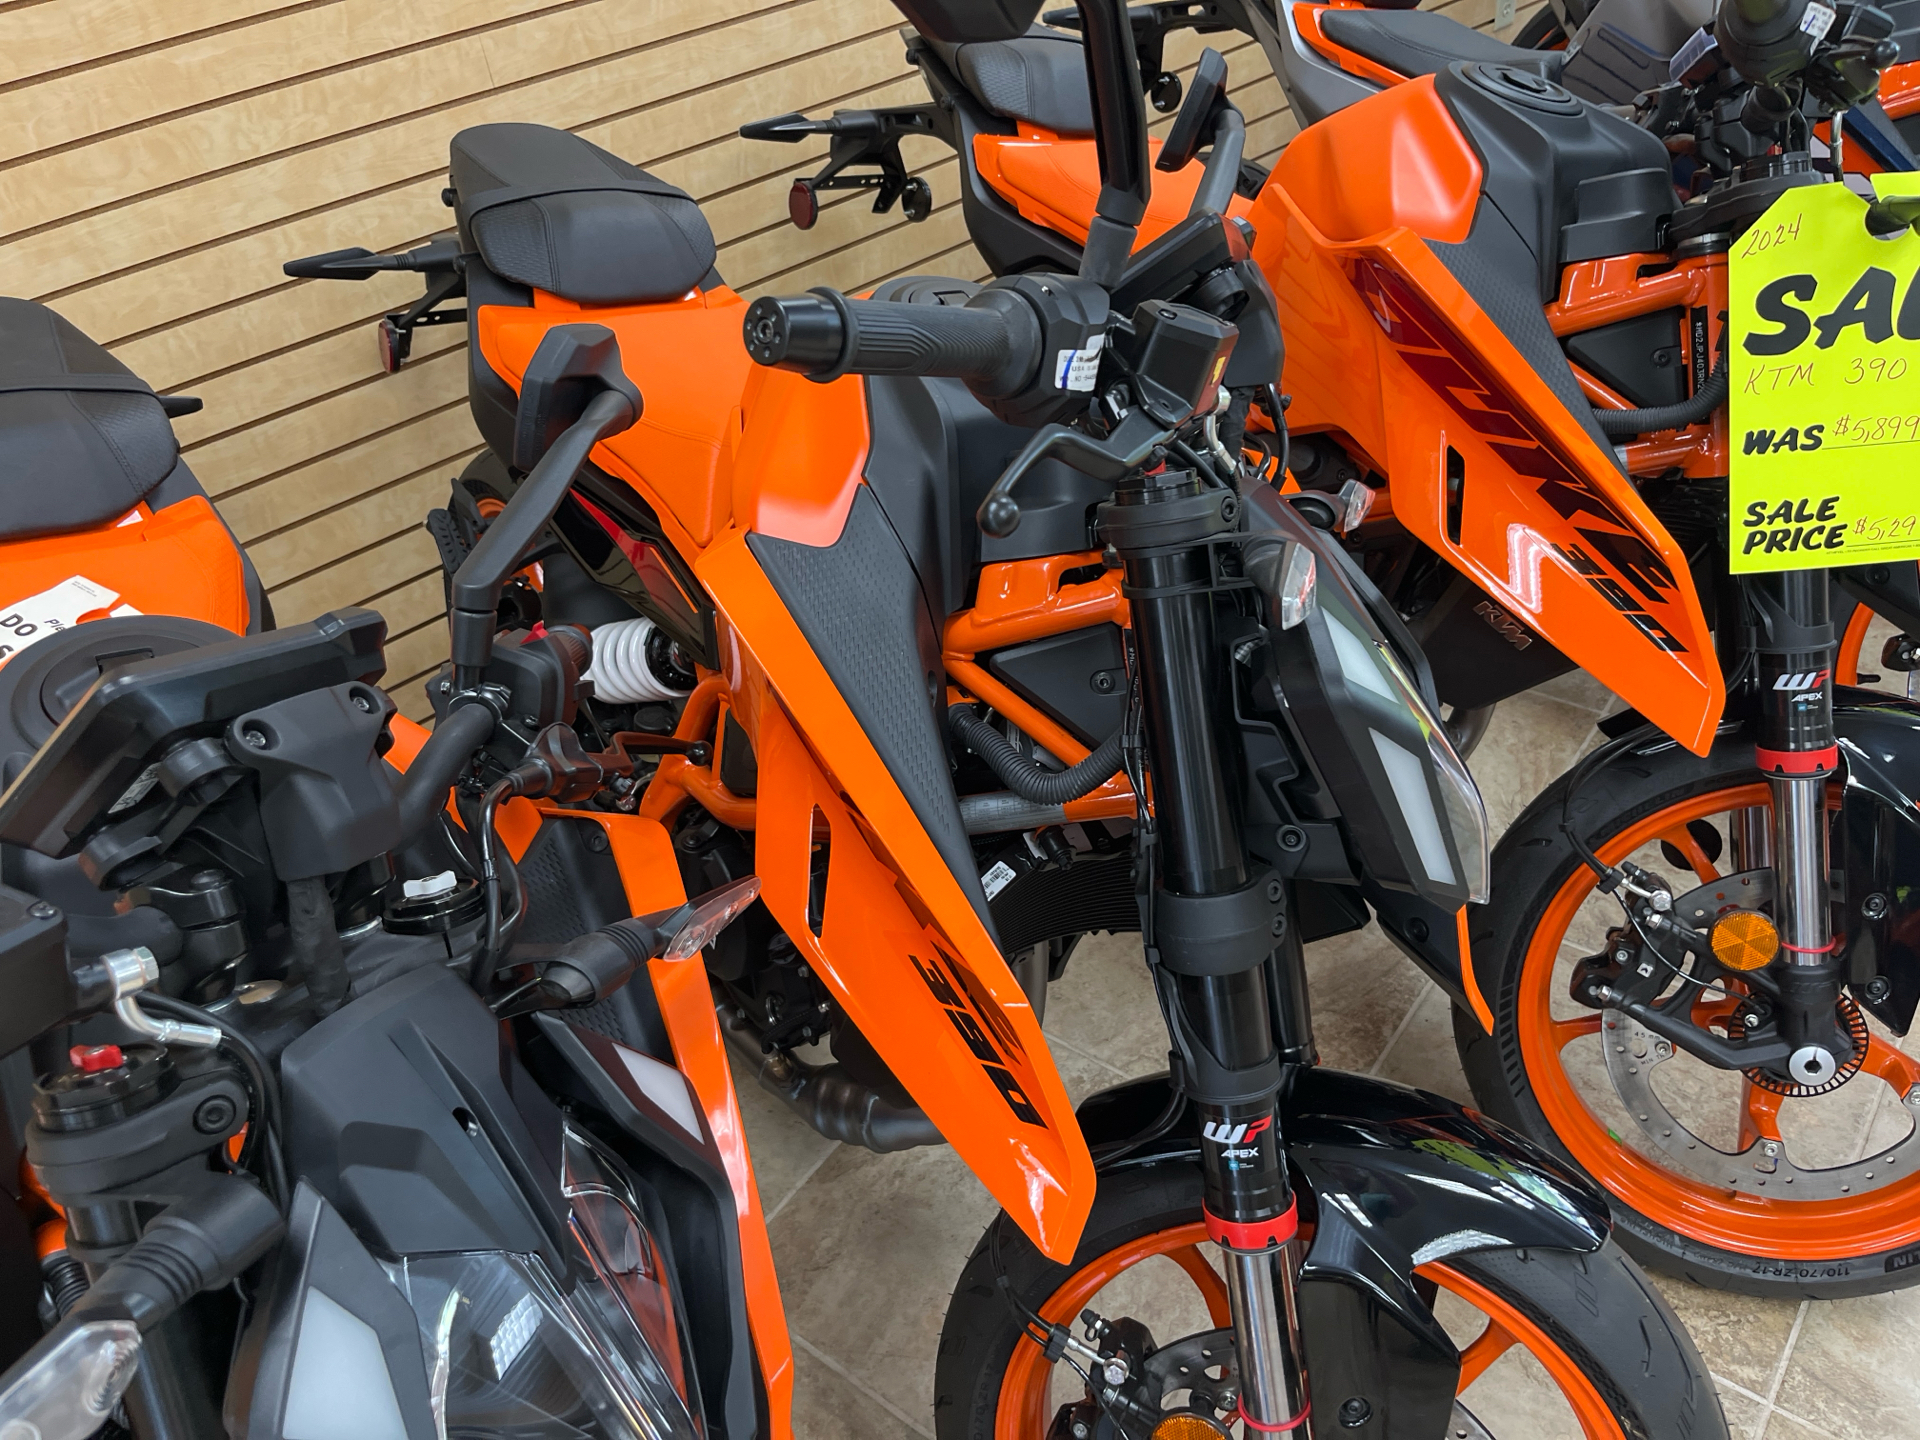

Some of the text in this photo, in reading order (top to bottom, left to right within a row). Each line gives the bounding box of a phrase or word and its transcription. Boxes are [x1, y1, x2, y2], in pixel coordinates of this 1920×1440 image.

[1742, 213, 1802, 259] 2024
[1744, 358, 1907, 396] KTM 390
[1742, 424, 1825, 456] WAS
[1742, 496, 1840, 527] SALE
[1742, 523, 1848, 555] PRICE
[1551, 543, 1690, 653] 390
[0, 612, 38, 637] DO
[1473, 601, 1533, 651] KTM
[1772, 668, 1831, 691] WP
[1791, 691, 1823, 702] APEX
[908, 955, 1049, 1130] 390
[1203, 1115, 1272, 1144] WP
[1221, 1147, 1259, 1158] APEX
[1799, 1267, 1850, 1278] 110/70
